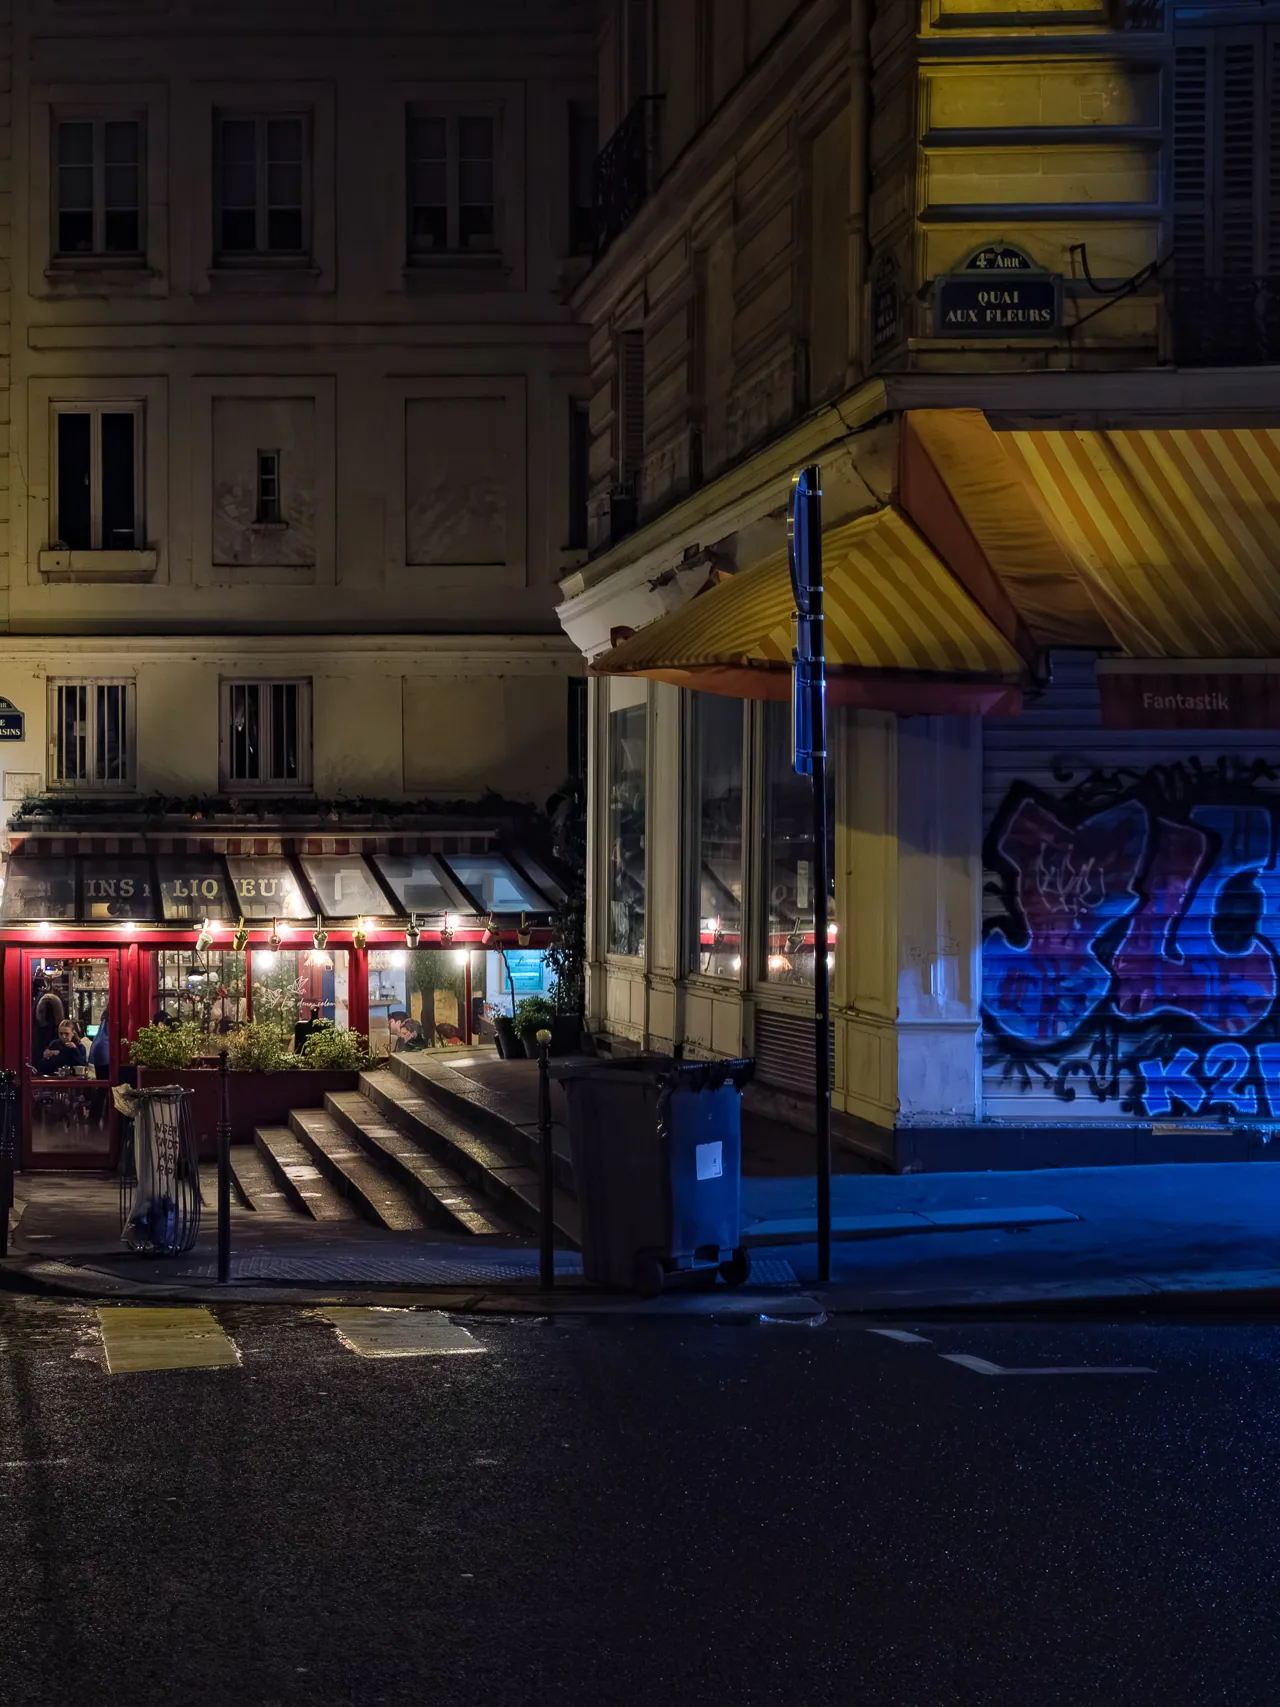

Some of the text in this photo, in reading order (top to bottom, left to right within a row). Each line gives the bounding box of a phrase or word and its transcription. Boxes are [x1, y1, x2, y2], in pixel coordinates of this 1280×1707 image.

[977, 291, 1019, 306] QUAI
[946, 309, 1051, 322] AUX FLEURS
[1142, 692, 1229, 711] Fantastik
